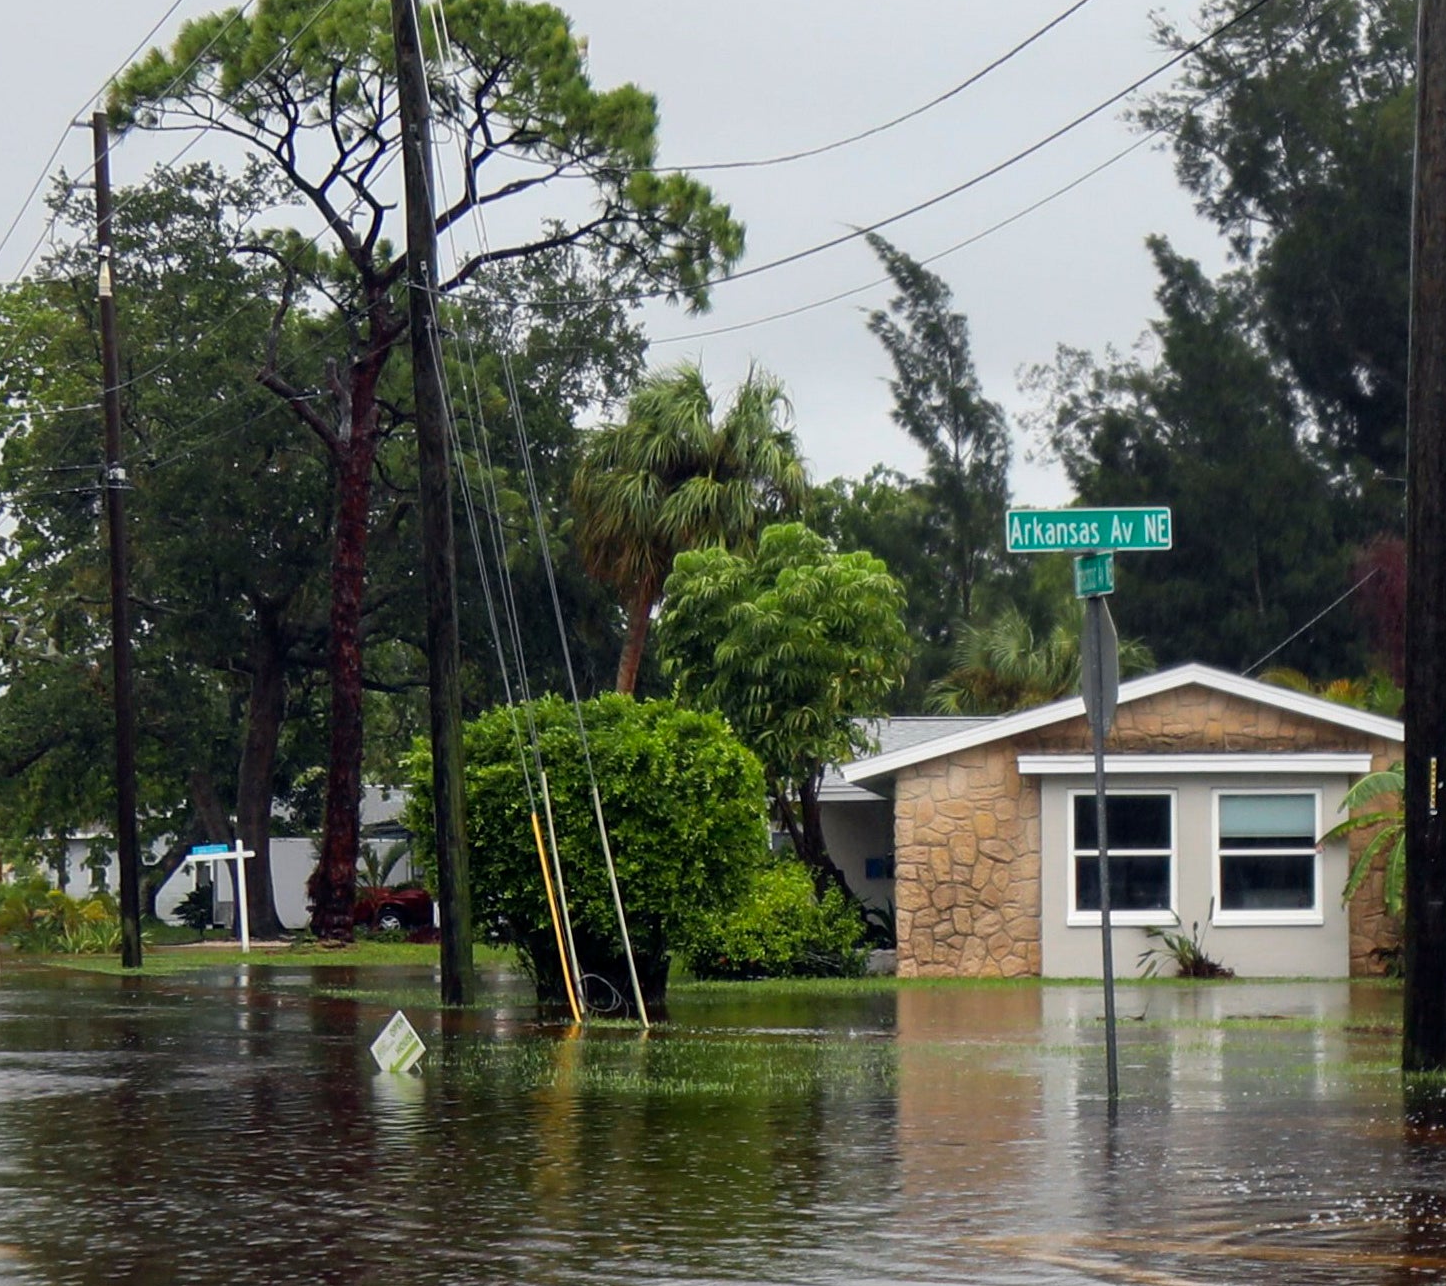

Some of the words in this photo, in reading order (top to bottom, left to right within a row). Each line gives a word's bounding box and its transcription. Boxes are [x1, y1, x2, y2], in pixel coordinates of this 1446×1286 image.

[1010, 516, 1100, 546] Arkansas
[1110, 514, 1133, 544] Av
[1144, 513, 1169, 544] NE
